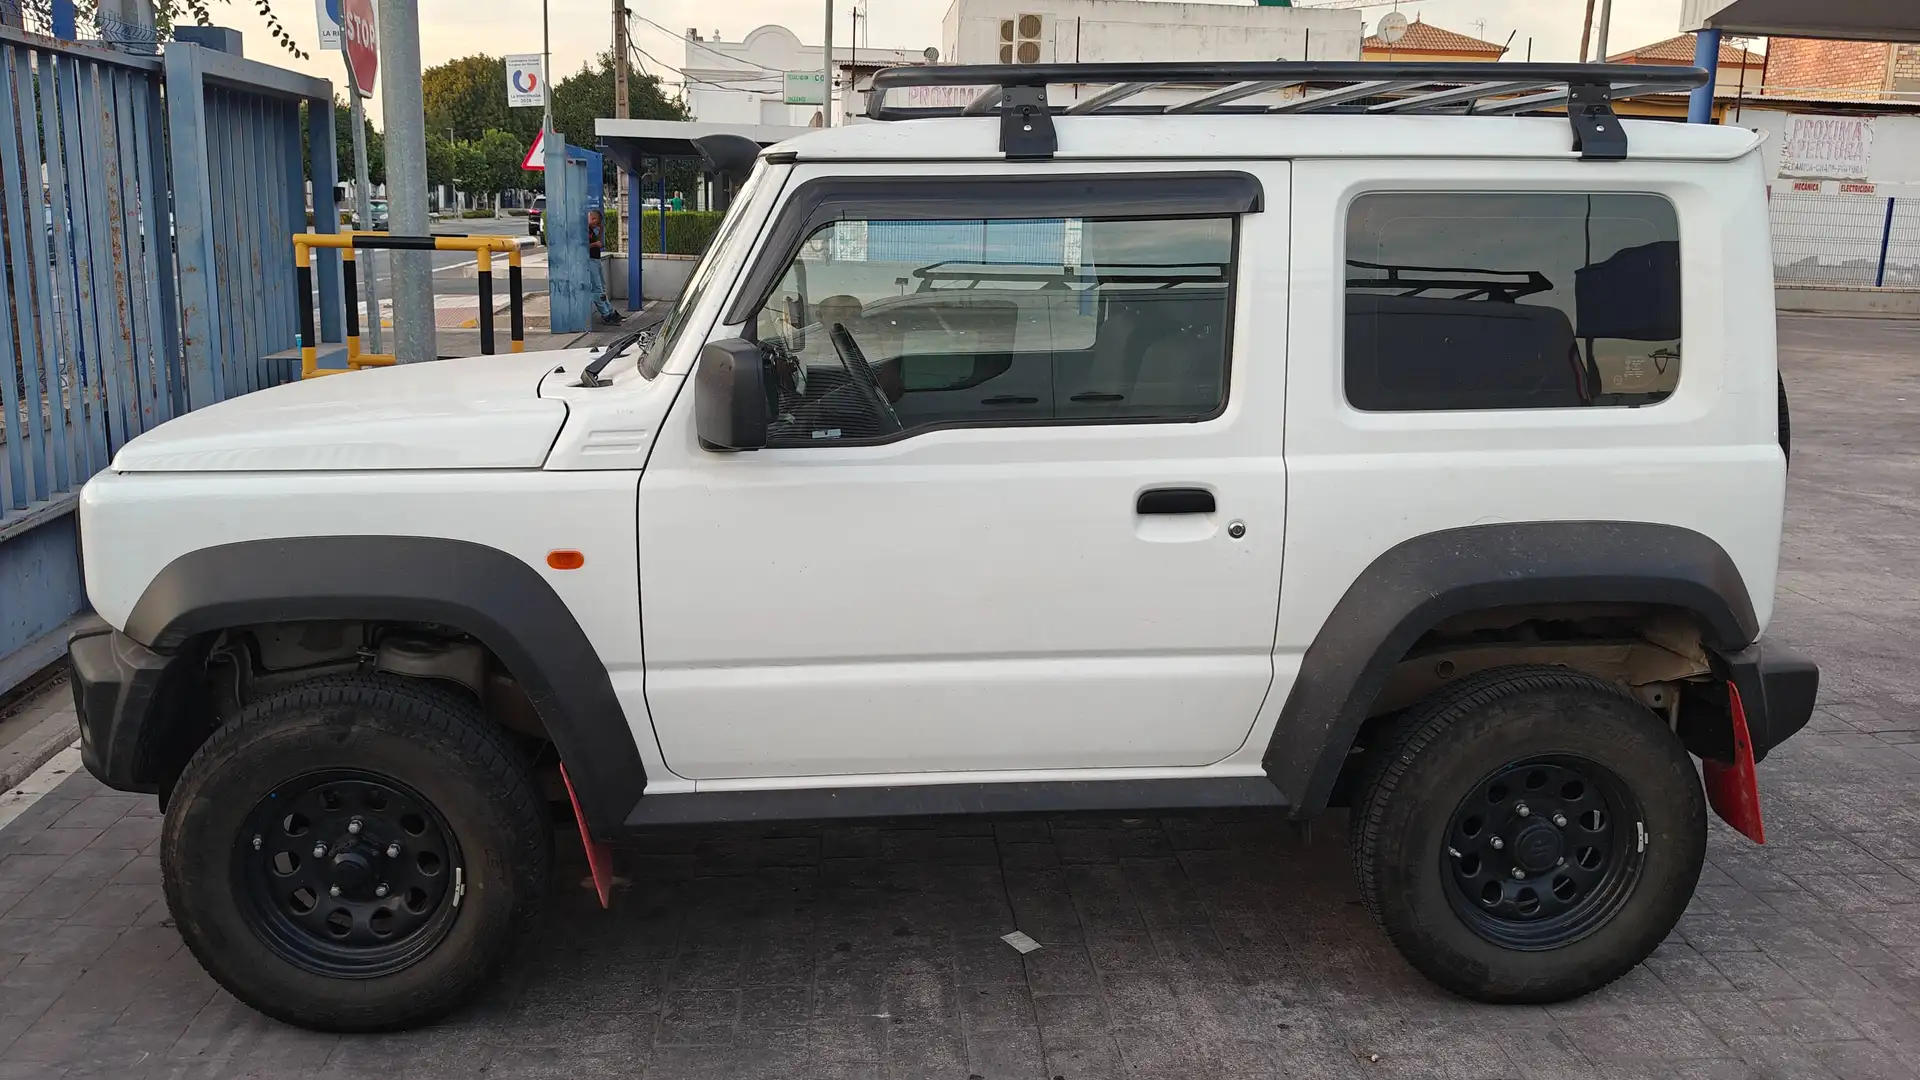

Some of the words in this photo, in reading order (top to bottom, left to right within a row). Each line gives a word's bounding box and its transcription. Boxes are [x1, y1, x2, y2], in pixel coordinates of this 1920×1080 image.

[347, 10, 375, 51] STOP
[1793, 119, 1862, 141] PROXIMA
[1840, 184, 1875, 193] ELECTRICIDAD
